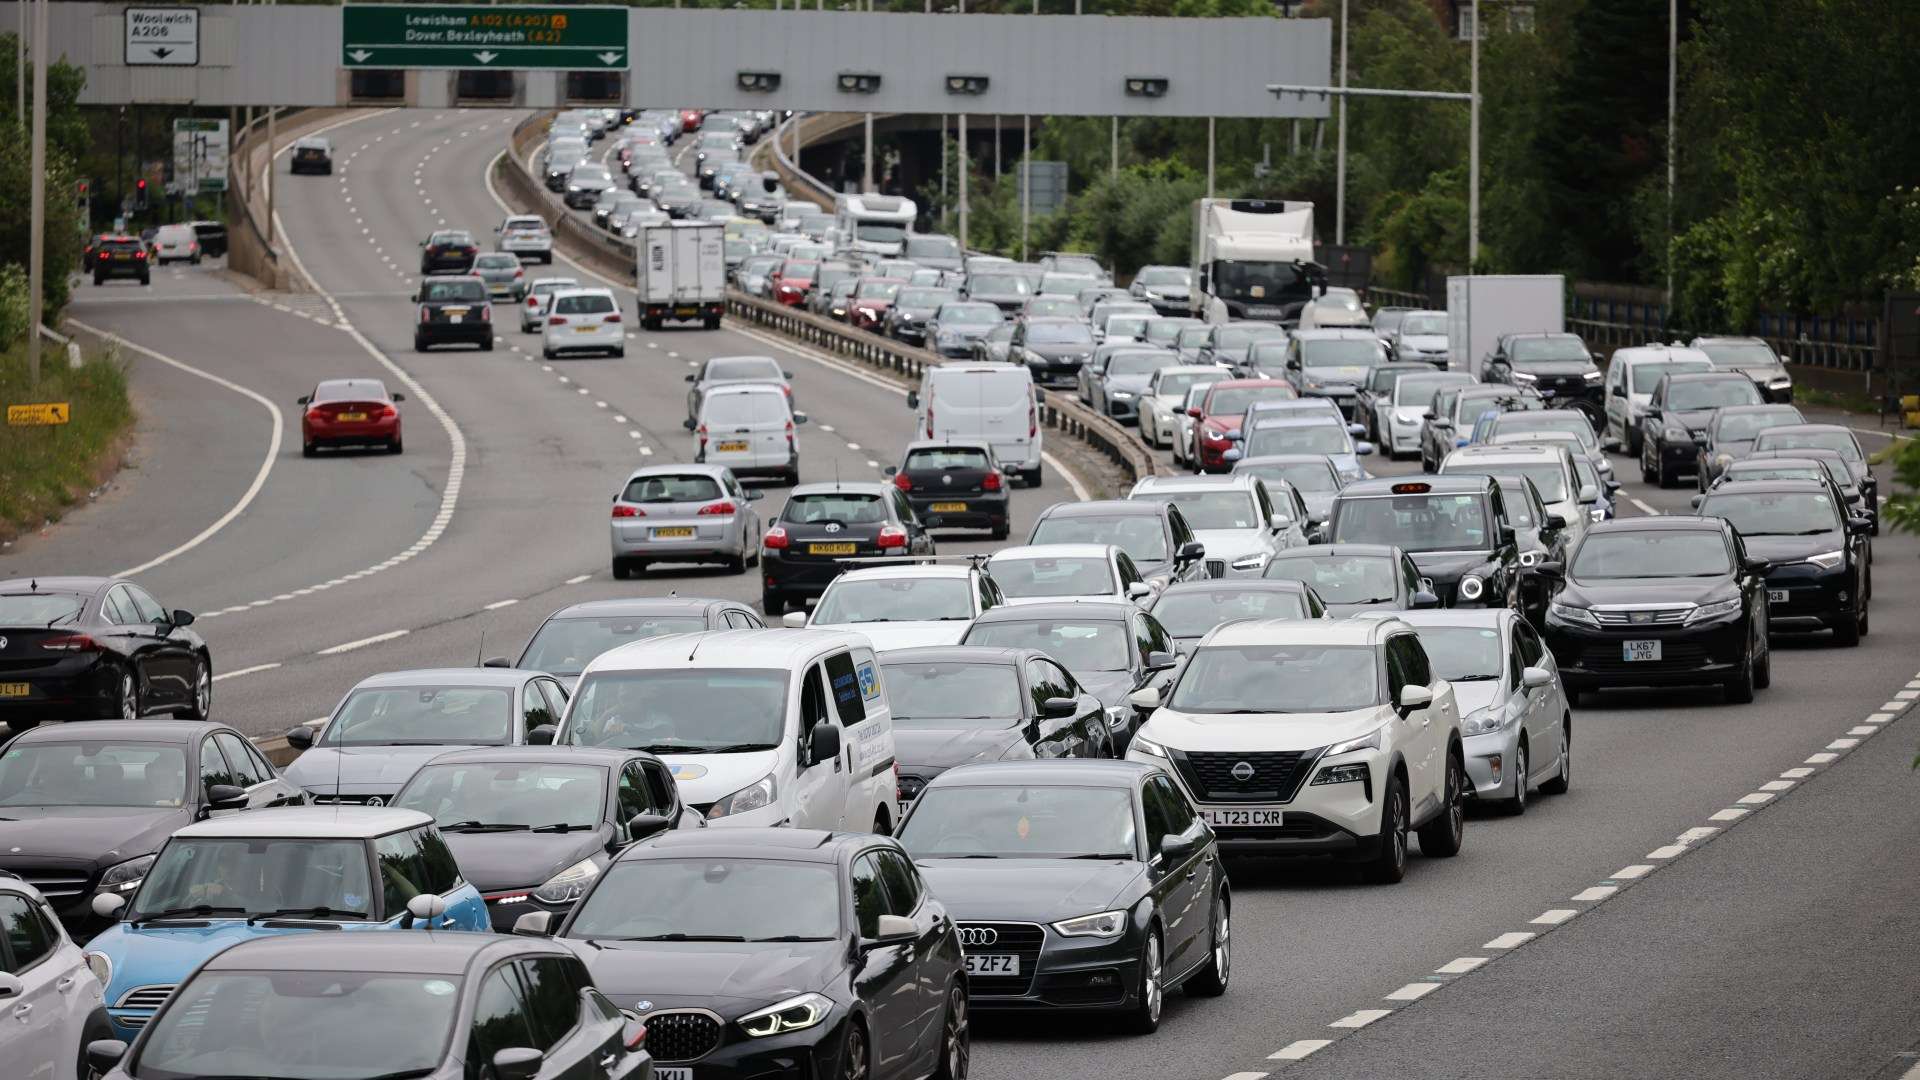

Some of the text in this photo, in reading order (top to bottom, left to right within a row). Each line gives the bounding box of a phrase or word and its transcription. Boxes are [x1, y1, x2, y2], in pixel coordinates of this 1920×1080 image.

[132, 13, 192, 25] Woolwich
[405, 14, 548, 27] Lewisham A102 (A20)
[131, 25, 169, 37] A206
[446, 29, 525, 43] Bexleyheath
[527, 30, 560, 42] (A2)
[652, 246, 664, 271] ALBION
[1768, 591, 1784, 601] GB
[1630, 641, 1655, 651] LK67
[1633, 651, 1652, 660] JYG
[1213, 811, 1249, 825] LT23
[1253, 811, 1280, 825] CXR
[980, 956, 1012, 972] ZFZ
